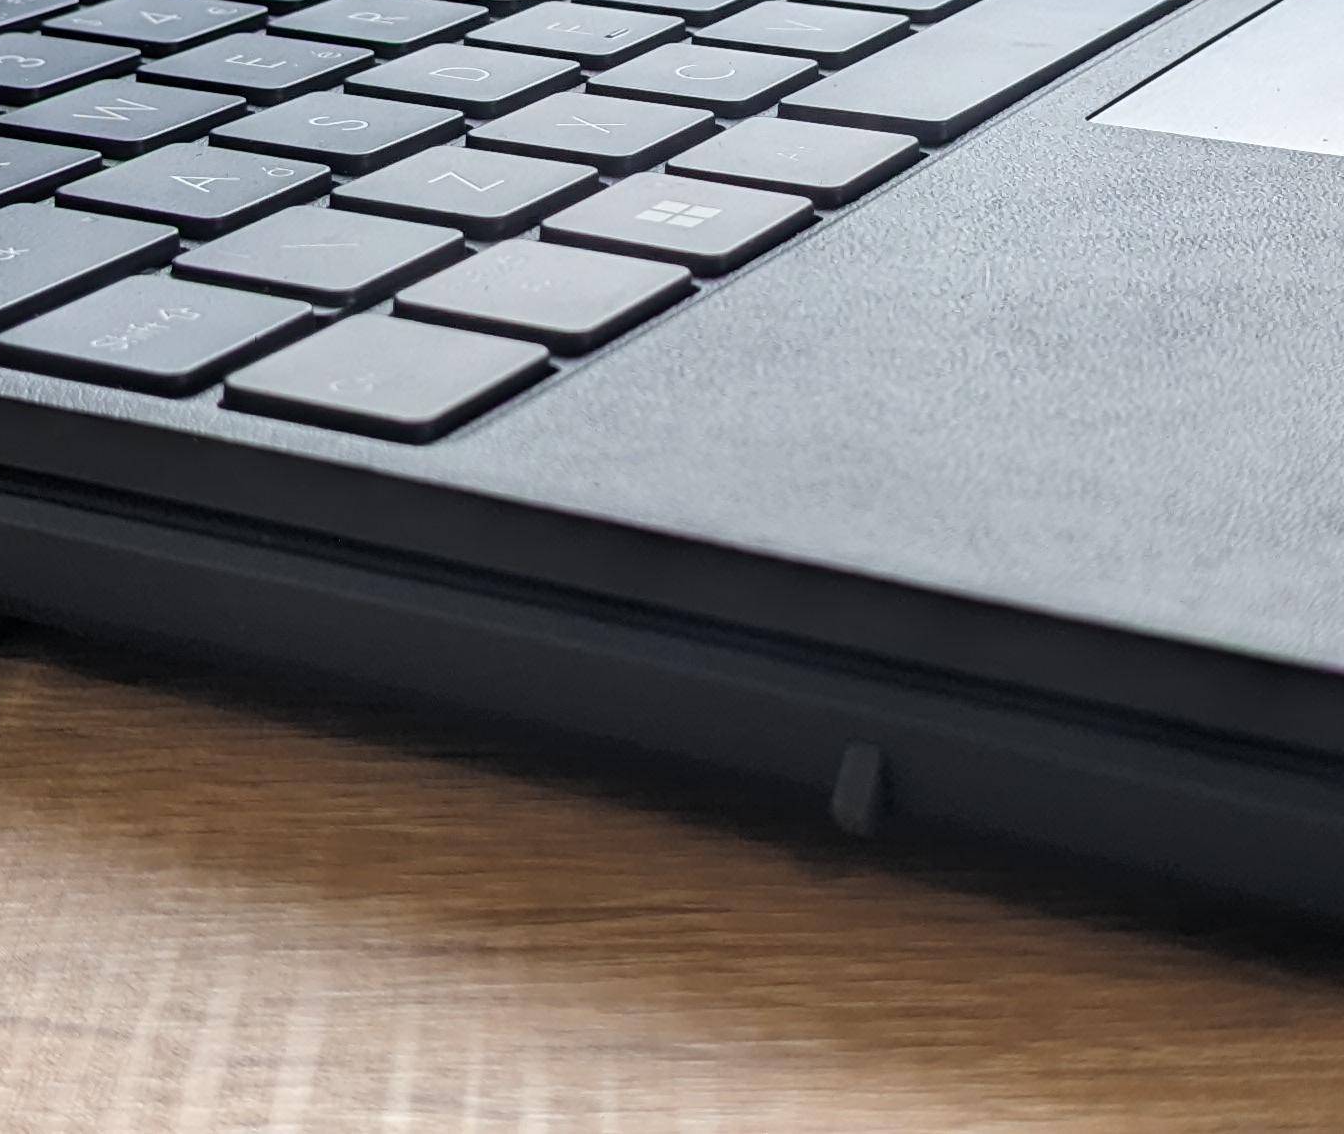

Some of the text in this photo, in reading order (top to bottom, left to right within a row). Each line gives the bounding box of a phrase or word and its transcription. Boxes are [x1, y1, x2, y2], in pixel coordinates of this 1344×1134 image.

[139, 9, 183, 26] 4
[346, 11, 410, 26] R
[763, 19, 825, 32] V
[545, 21, 594, 36] F
[224, 53, 288, 70] E
[427, 65, 491, 83] D
[674, 63, 737, 81] C
[71, 97, 160, 122] W
[307, 115, 370, 132] S
[554, 115, 627, 135] X
[169, 173, 242, 194] A
[426, 169, 505, 193] Z
